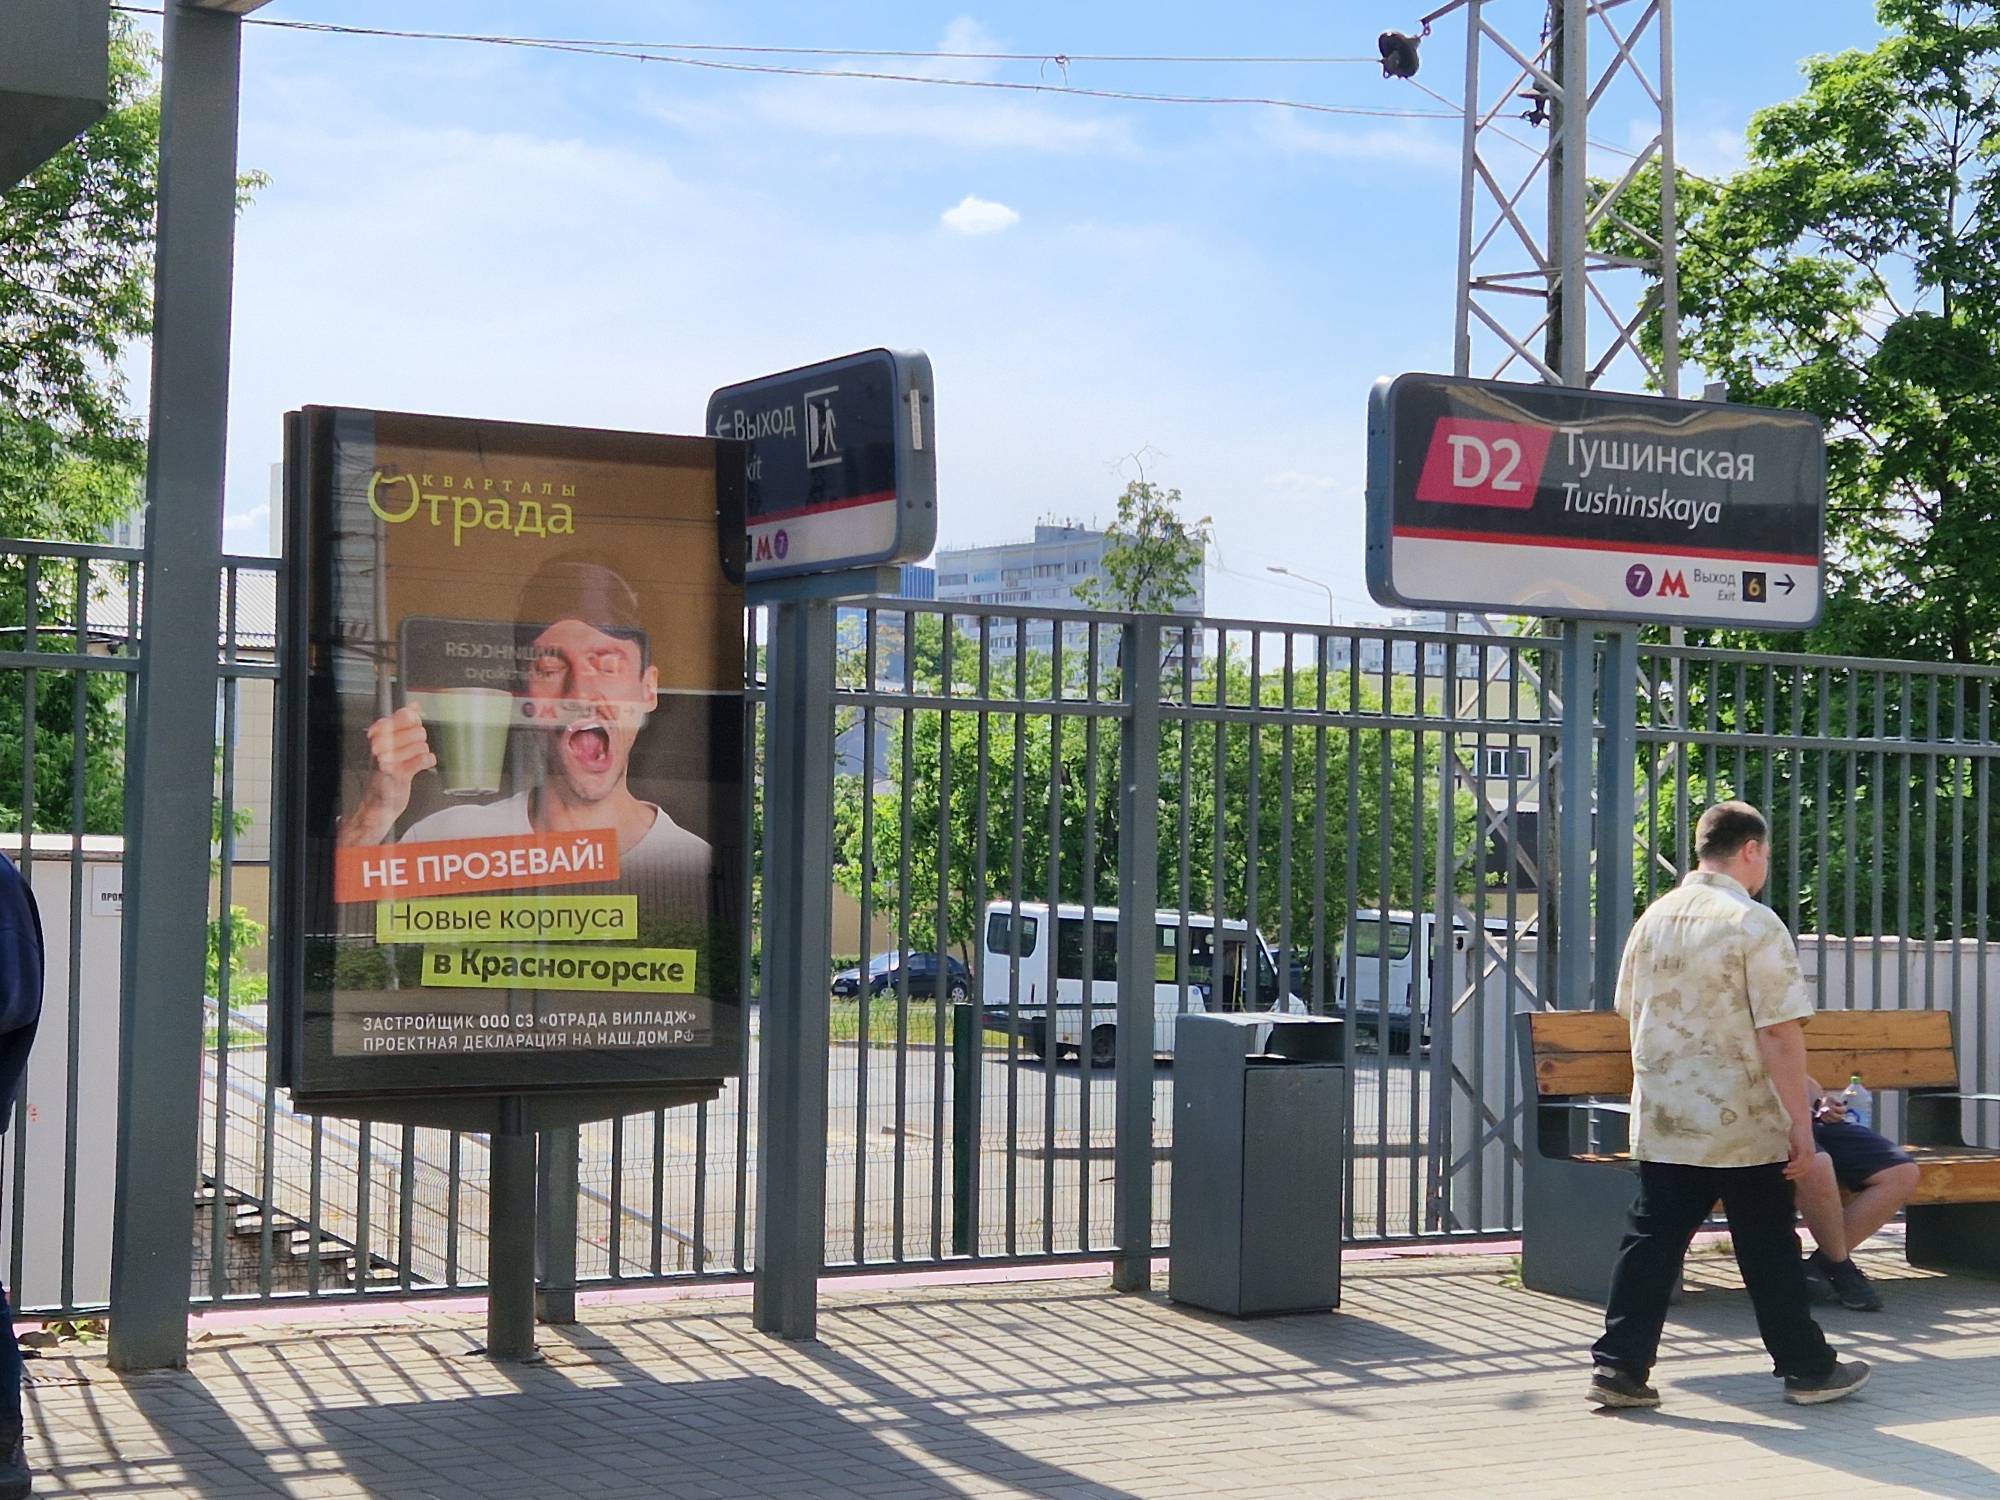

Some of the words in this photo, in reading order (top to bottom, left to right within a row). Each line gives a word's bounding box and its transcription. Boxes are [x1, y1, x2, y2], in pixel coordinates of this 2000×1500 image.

[734, 406, 796, 441] Выход
[745, 453, 762, 481] xit
[1447, 434, 1523, 491] D2
[1559, 427, 1755, 482] Тушинская
[422, 473, 577, 497] КВАРТАЛЫ
[367, 471, 575, 547] Отрада
[1561, 482, 1722, 530] Tushinskaya
[1633, 570, 1646, 590] 7
[1694, 568, 1736, 586] Выход
[1749, 578, 1761, 597] 6
[1717, 590, 1736, 602] Exit
[362, 858, 408, 888] НЕ
[416, 838, 605, 883] ПРОЗЕВАЙ!
[390, 903, 491, 931] Новые
[500, 904, 625, 936] корпуса
[433, 953, 451, 975] в
[460, 948, 685, 987] Красногорске
[362, 1013, 475, 1032] ЗАСТРОЙЩИК
[479, 1014, 510, 1029] ООО
[515, 1013, 534, 1028] СЗ
[539, 1011, 608, 1029] «ОТРАДА
[612, 1010, 697, 1027] ВИЛЛАДЖ»
[363, 1035, 457, 1052] ПРОЕКТНАЯ
[463, 1032, 567, 1052] ДЕКЛАРАЦИЯ
[572, 1031, 592, 1046] НА
